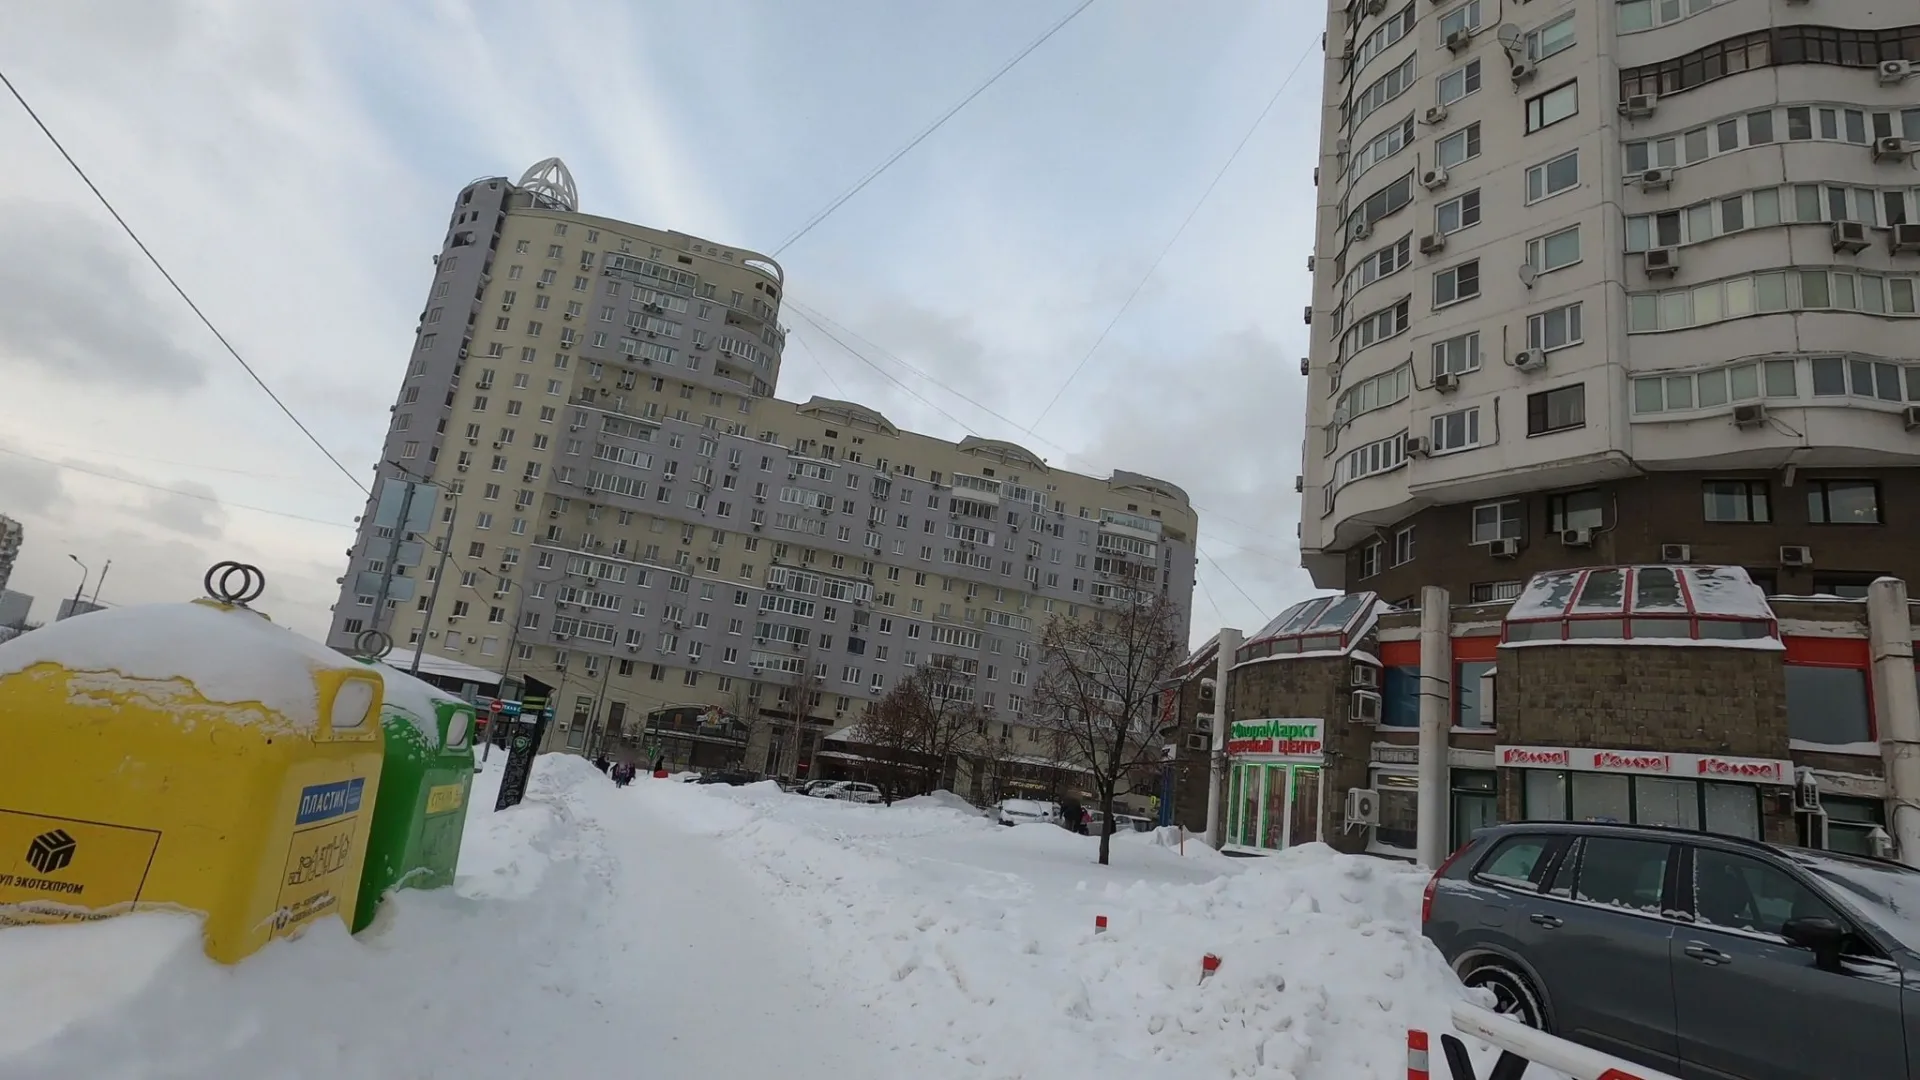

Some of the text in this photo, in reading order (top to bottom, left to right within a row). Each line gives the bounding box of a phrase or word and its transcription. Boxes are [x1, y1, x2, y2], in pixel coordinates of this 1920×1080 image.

[1279, 740, 1321, 755] ЦЕНТР
[301, 789, 346, 815] ПЛАСТИК
[15, 876, 84, 894] ЭКОТЕХПРОМ
